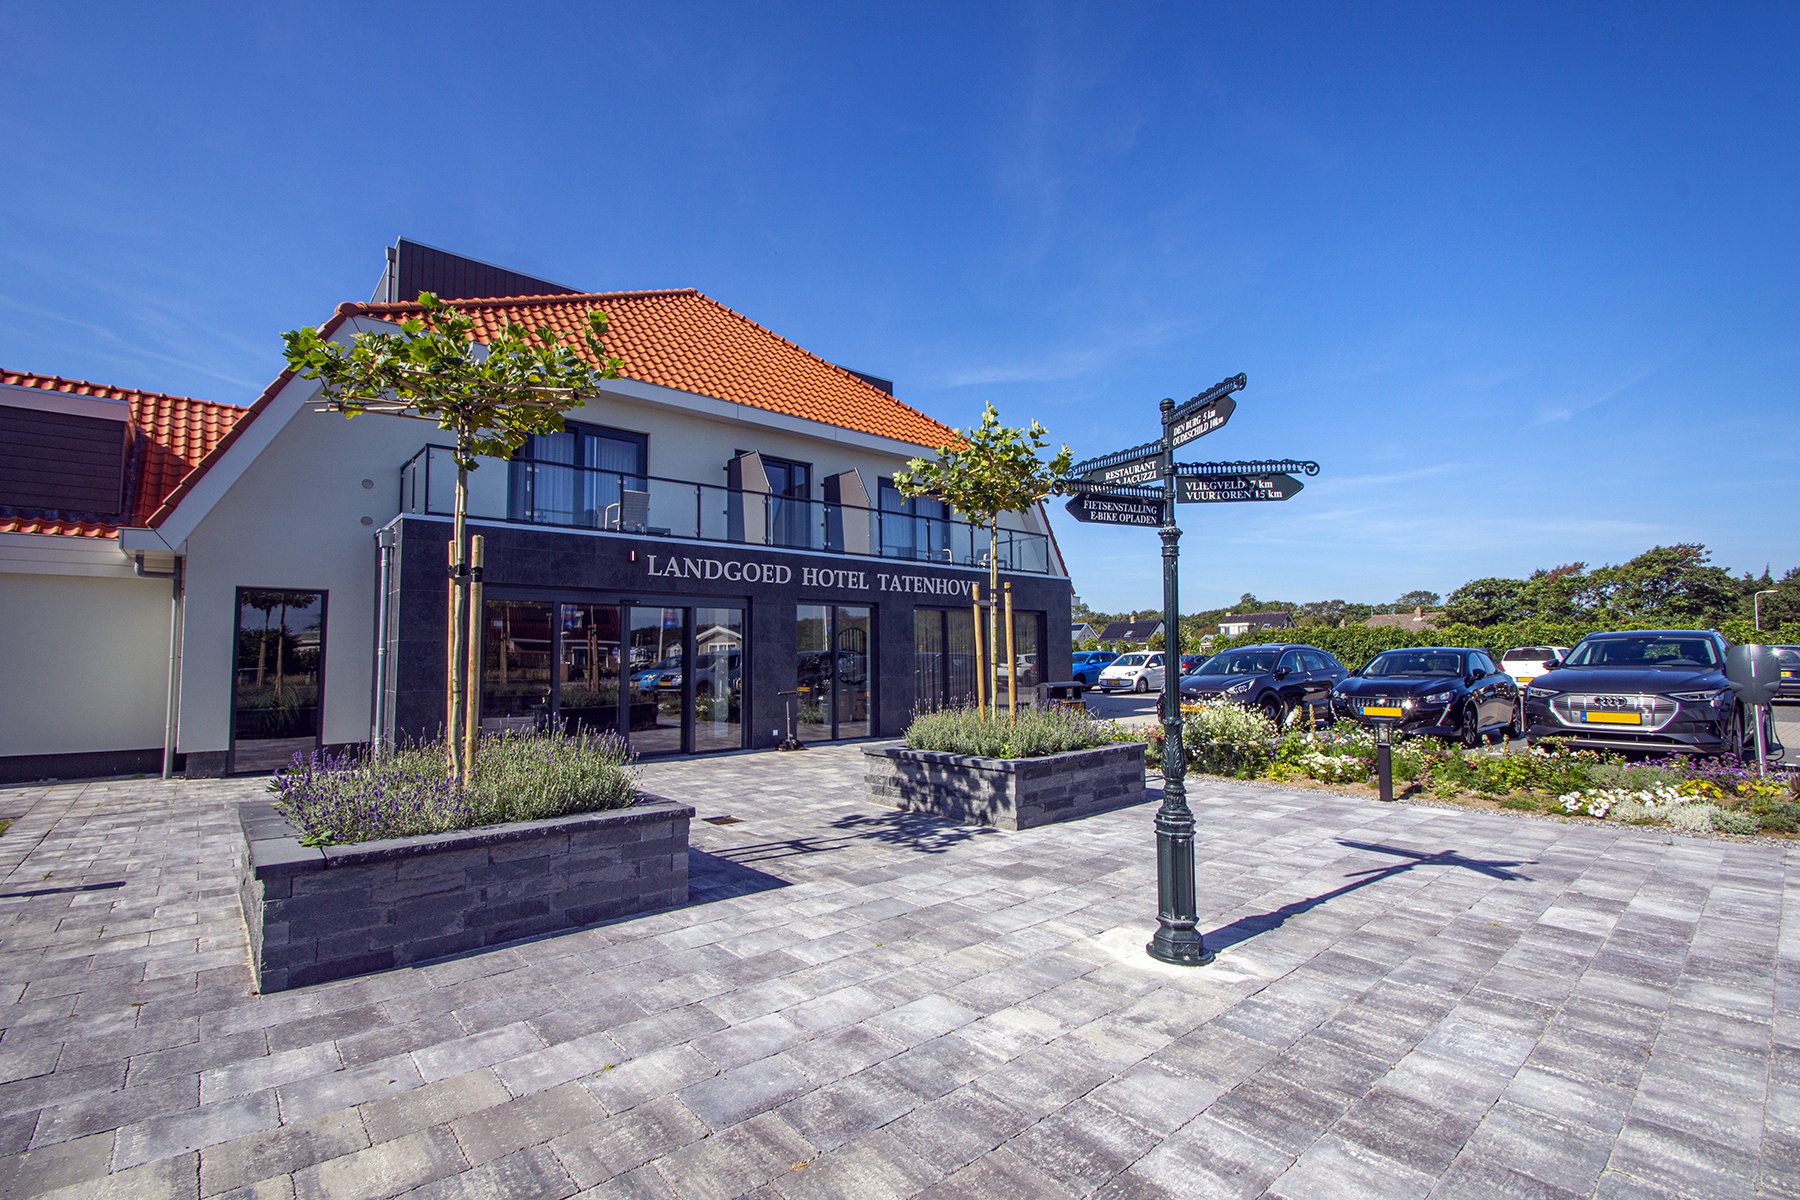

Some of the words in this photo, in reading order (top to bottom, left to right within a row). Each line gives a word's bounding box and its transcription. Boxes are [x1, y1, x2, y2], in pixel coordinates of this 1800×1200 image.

[1172, 422, 1209, 446] OUDESCHILD
[1173, 423, 1186, 436] DEN
[1105, 461, 1157, 480] RESTAURANT
[1123, 470, 1157, 485] JACUZZI
[1185, 480, 1246, 491] VLIEGVELD
[1249, 480, 1256, 489] 7
[1258, 480, 1274, 489] km
[1185, 490, 1252, 501] VUURTOREN
[1255, 490, 1266, 499] 15
[1267, 490, 1283, 499] km
[1083, 500, 1158, 515] FIETSENSTALLING
[1090, 511, 1118, 522] E-BIKE
[1118, 513, 1157, 525] OPLADEN
[647, 554, 792, 584] LANDGOED
[801, 567, 869, 590] HOTEL
[877, 573, 980, 597] TATENHOV
